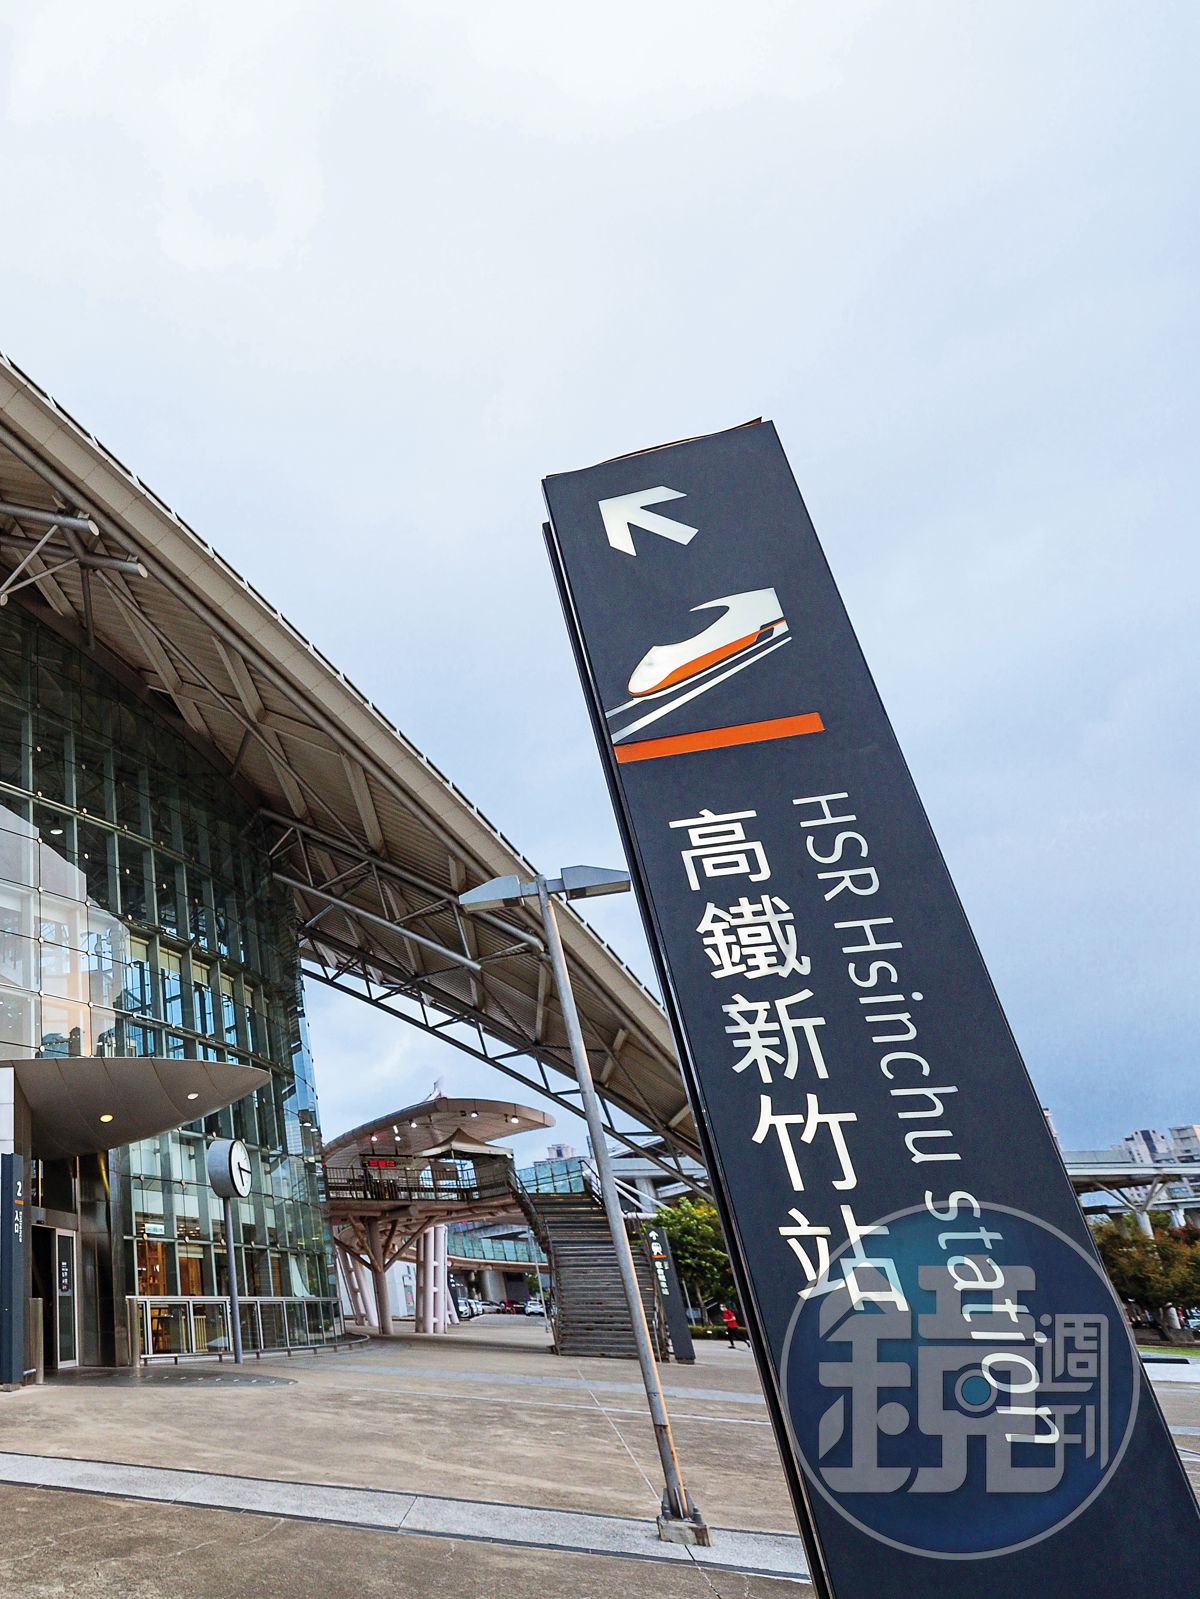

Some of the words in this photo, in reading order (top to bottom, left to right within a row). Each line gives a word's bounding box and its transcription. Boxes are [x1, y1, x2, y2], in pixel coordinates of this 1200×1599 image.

[793, 791, 880, 902] HSR
[668, 808, 909, 1312] 高鐵新竹站
[834, 917, 961, 1164] Hsinchu
[16, 1180, 22, 1197] 2
[924, 1190, 1060, 1445] station
